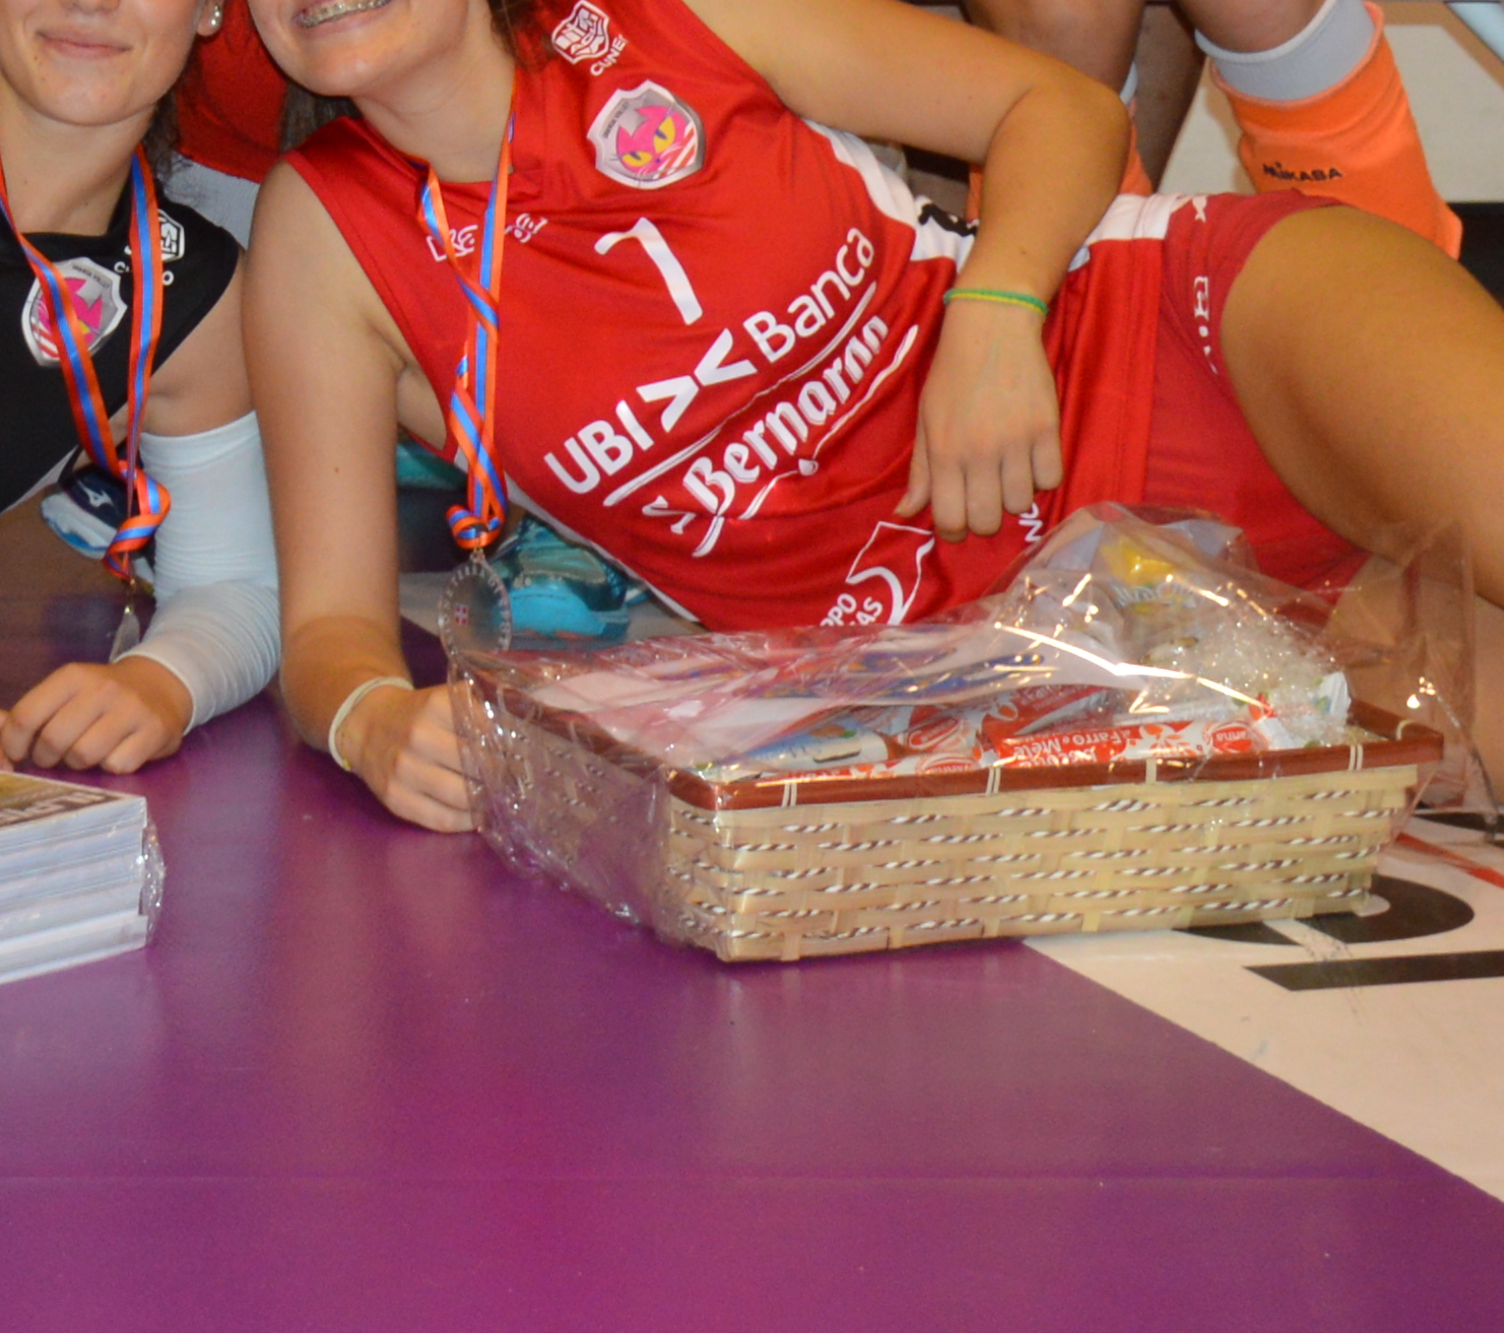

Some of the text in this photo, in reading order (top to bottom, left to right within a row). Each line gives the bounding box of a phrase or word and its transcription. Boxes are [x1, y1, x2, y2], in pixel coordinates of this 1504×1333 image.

[1262, 161, 1343, 182] MIKASA
[594, 217, 704, 326] 7
[543, 225, 877, 498] UBI Banca
